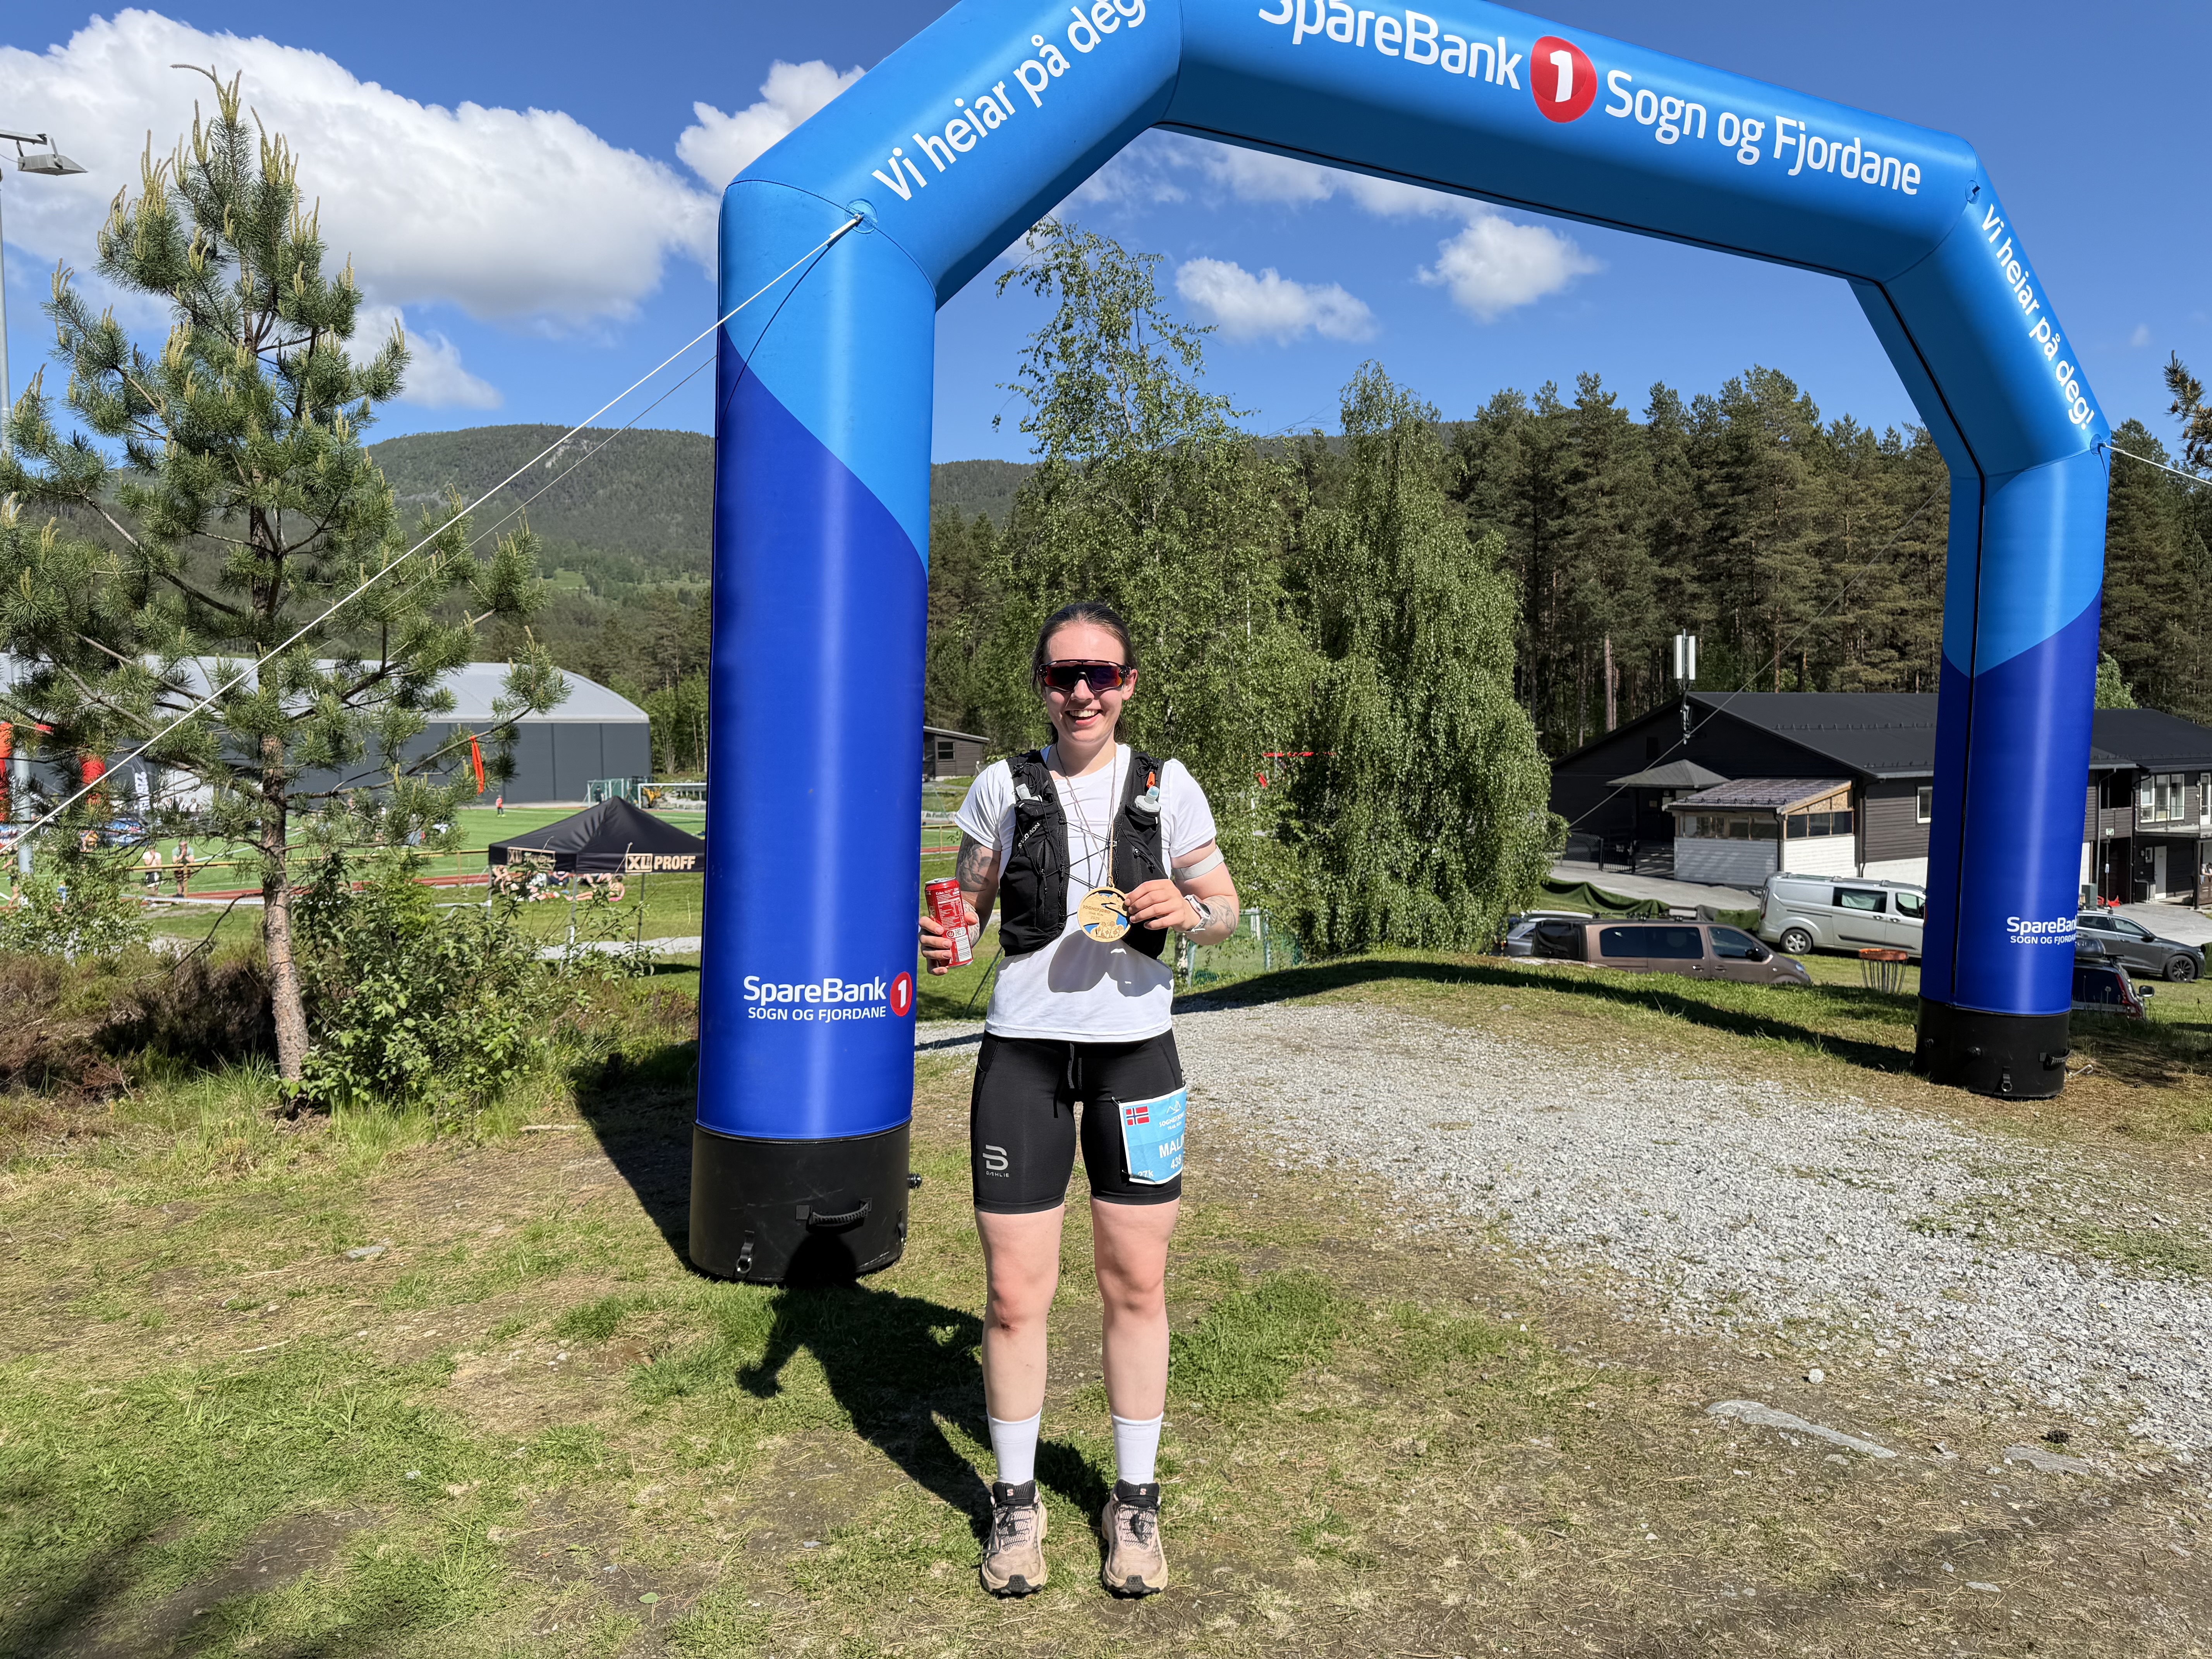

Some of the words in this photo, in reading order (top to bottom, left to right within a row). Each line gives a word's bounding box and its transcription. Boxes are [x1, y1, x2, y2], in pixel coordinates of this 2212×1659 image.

[871, 147, 927, 201] Vi
[912, 81, 1015, 173] heiar
[1013, 34, 1071, 108] på
[1067, 0, 1146, 53] deg
[1550, 50, 1573, 103] 1
[1605, 70, 1706, 145] Sogn
[1718, 112, 1765, 165] og
[1773, 115, 1921, 195] Fjordane
[1982, 204, 2005, 244] Vi
[1996, 237, 2040, 316] heiar
[2028, 316, 2061, 361] på
[2055, 360, 2095, 431] deg!
[628, 856, 650, 870] XL
[654, 855, 696, 870] PROFF
[2010, 935, 2038, 944] SOGN
[744, 975, 887, 1006] SpareBank
[898, 979, 907, 1008] 1
[748, 1007, 788, 1020] SOGN
[792, 1009, 814, 1021] OG
[818, 1006, 886, 1023] FJORDANE
[1171, 1154, 1181, 1169] 438
